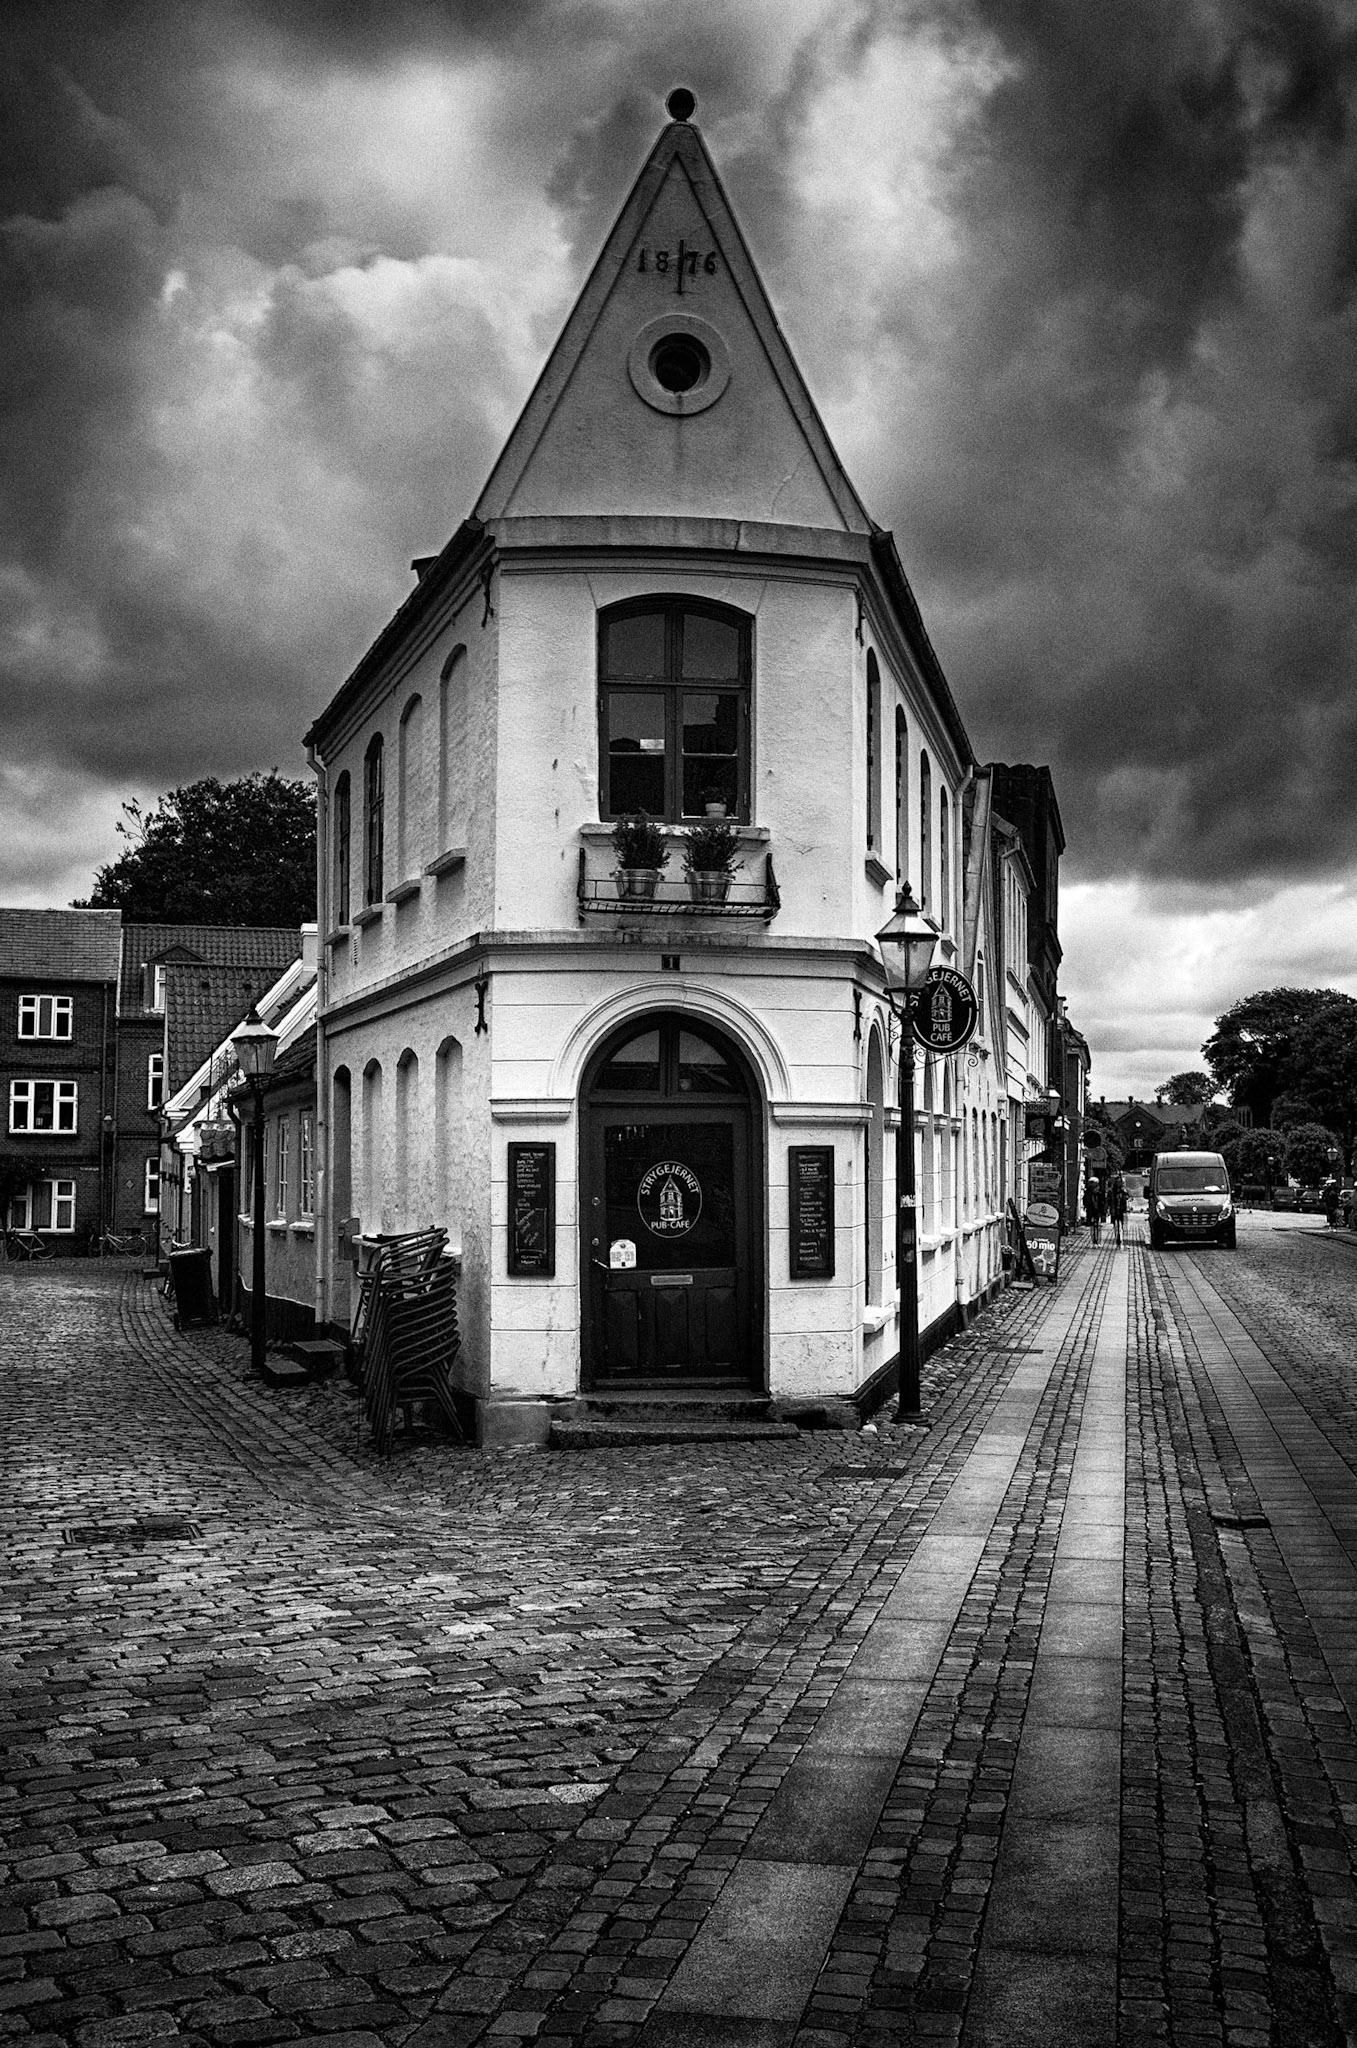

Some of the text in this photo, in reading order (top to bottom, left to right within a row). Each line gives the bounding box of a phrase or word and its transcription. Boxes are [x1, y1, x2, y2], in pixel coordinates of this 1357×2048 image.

[637, 247, 717, 276] 1876
[932, 1023, 951, 1032] PUB
[930, 1032, 953, 1042] CAFÉ
[640, 1163, 700, 1196] STRYGEJERNET
[1026, 1240, 1056, 1251] 50 mio
